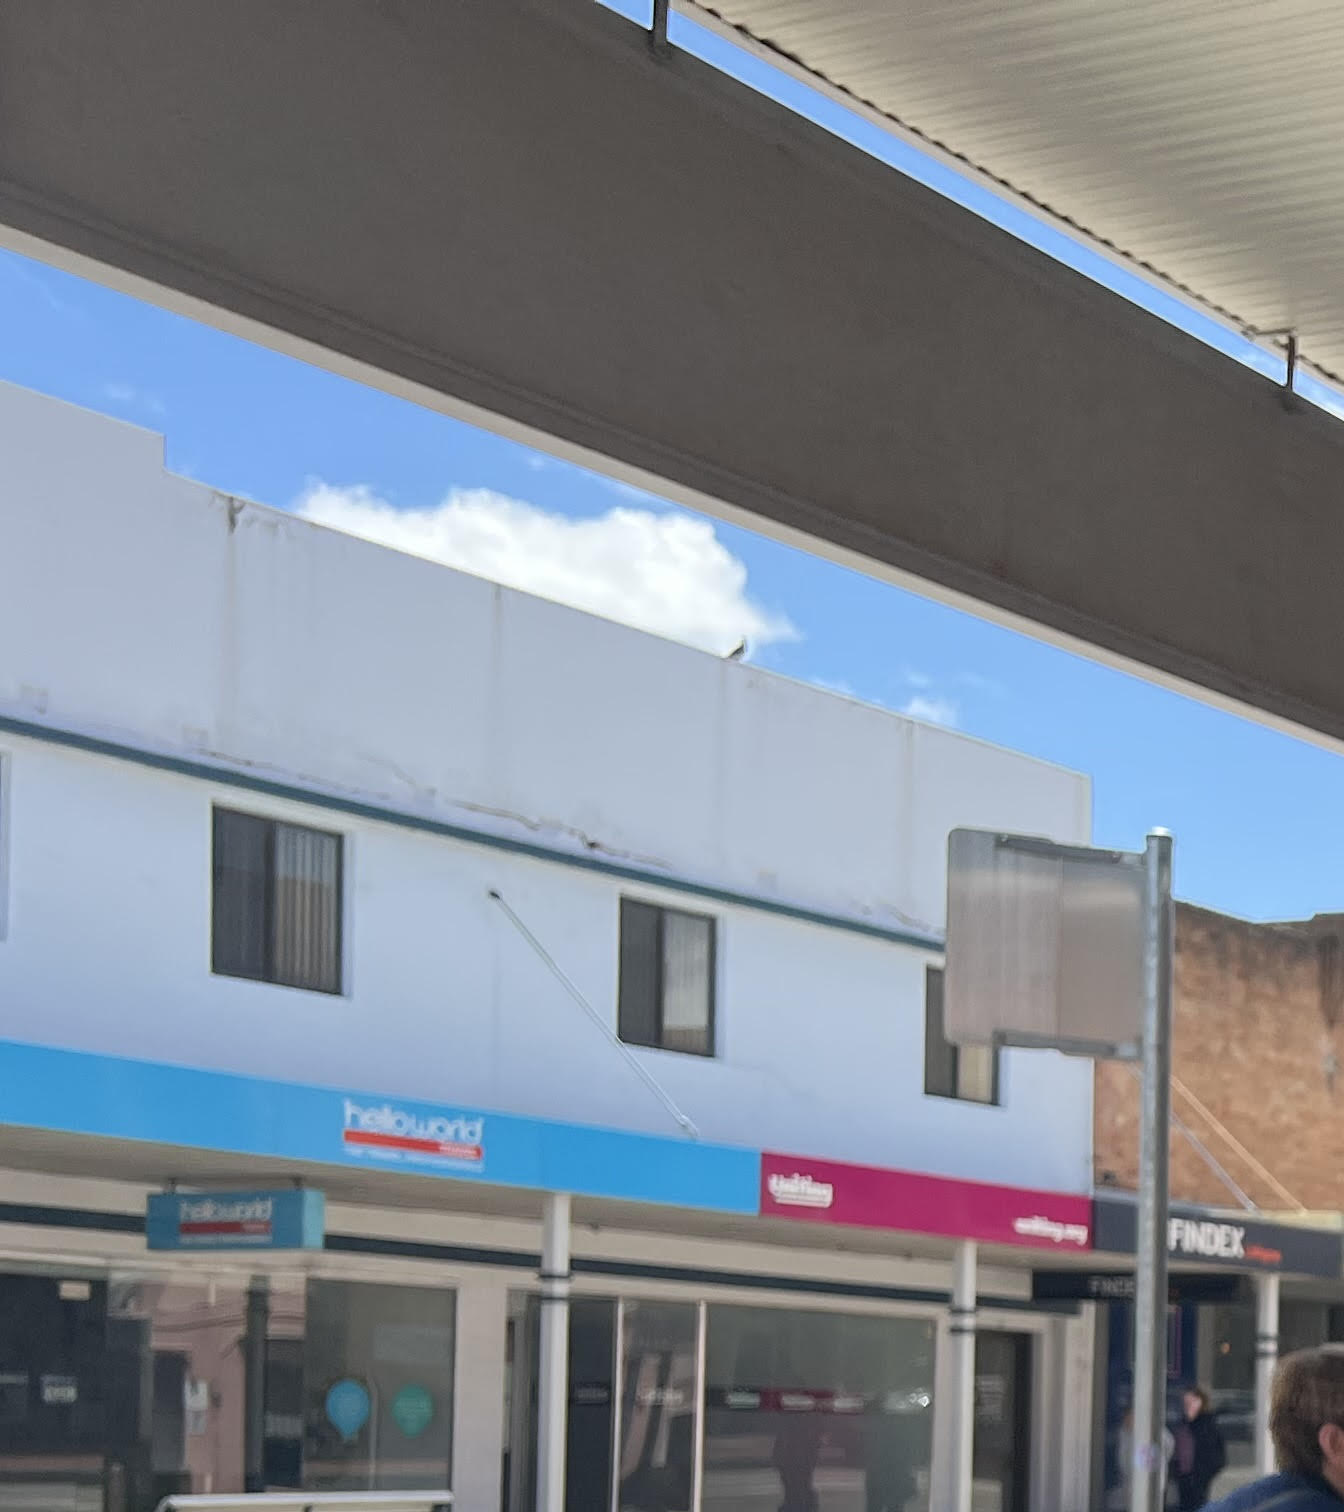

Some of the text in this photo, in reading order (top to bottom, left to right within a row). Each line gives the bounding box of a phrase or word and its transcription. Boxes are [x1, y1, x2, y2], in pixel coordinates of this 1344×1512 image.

[342, 1098, 484, 1145] helloworld
[179, 1196, 272, 1222] helloworld
[1168, 1217, 1245, 1259] FINDEX
